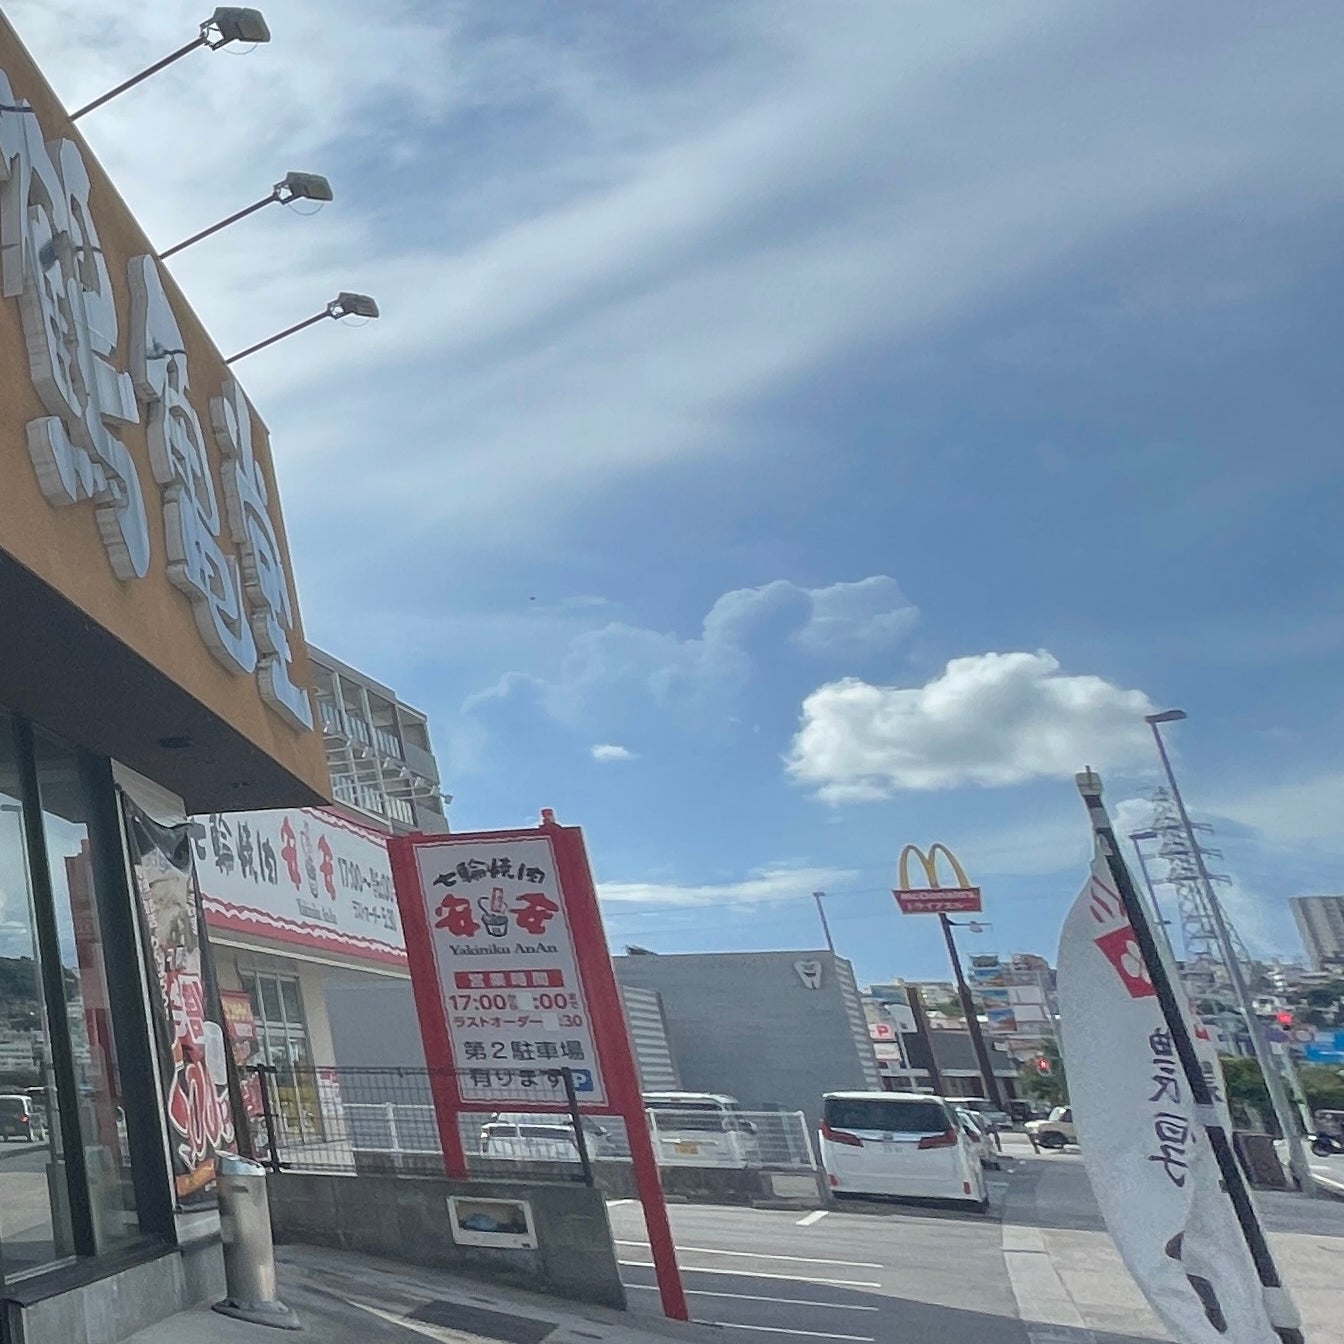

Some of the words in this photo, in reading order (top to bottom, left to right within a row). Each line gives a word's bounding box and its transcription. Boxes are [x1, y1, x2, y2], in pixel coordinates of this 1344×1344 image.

[432, 857, 546, 887] 七輪焼肉
[448, 944, 511, 956] Yakiniku
[514, 942, 560, 954] AnAn
[453, 1014, 544, 1029] ラストオーダー
[463, 1040, 586, 1060] 第2駐車場
